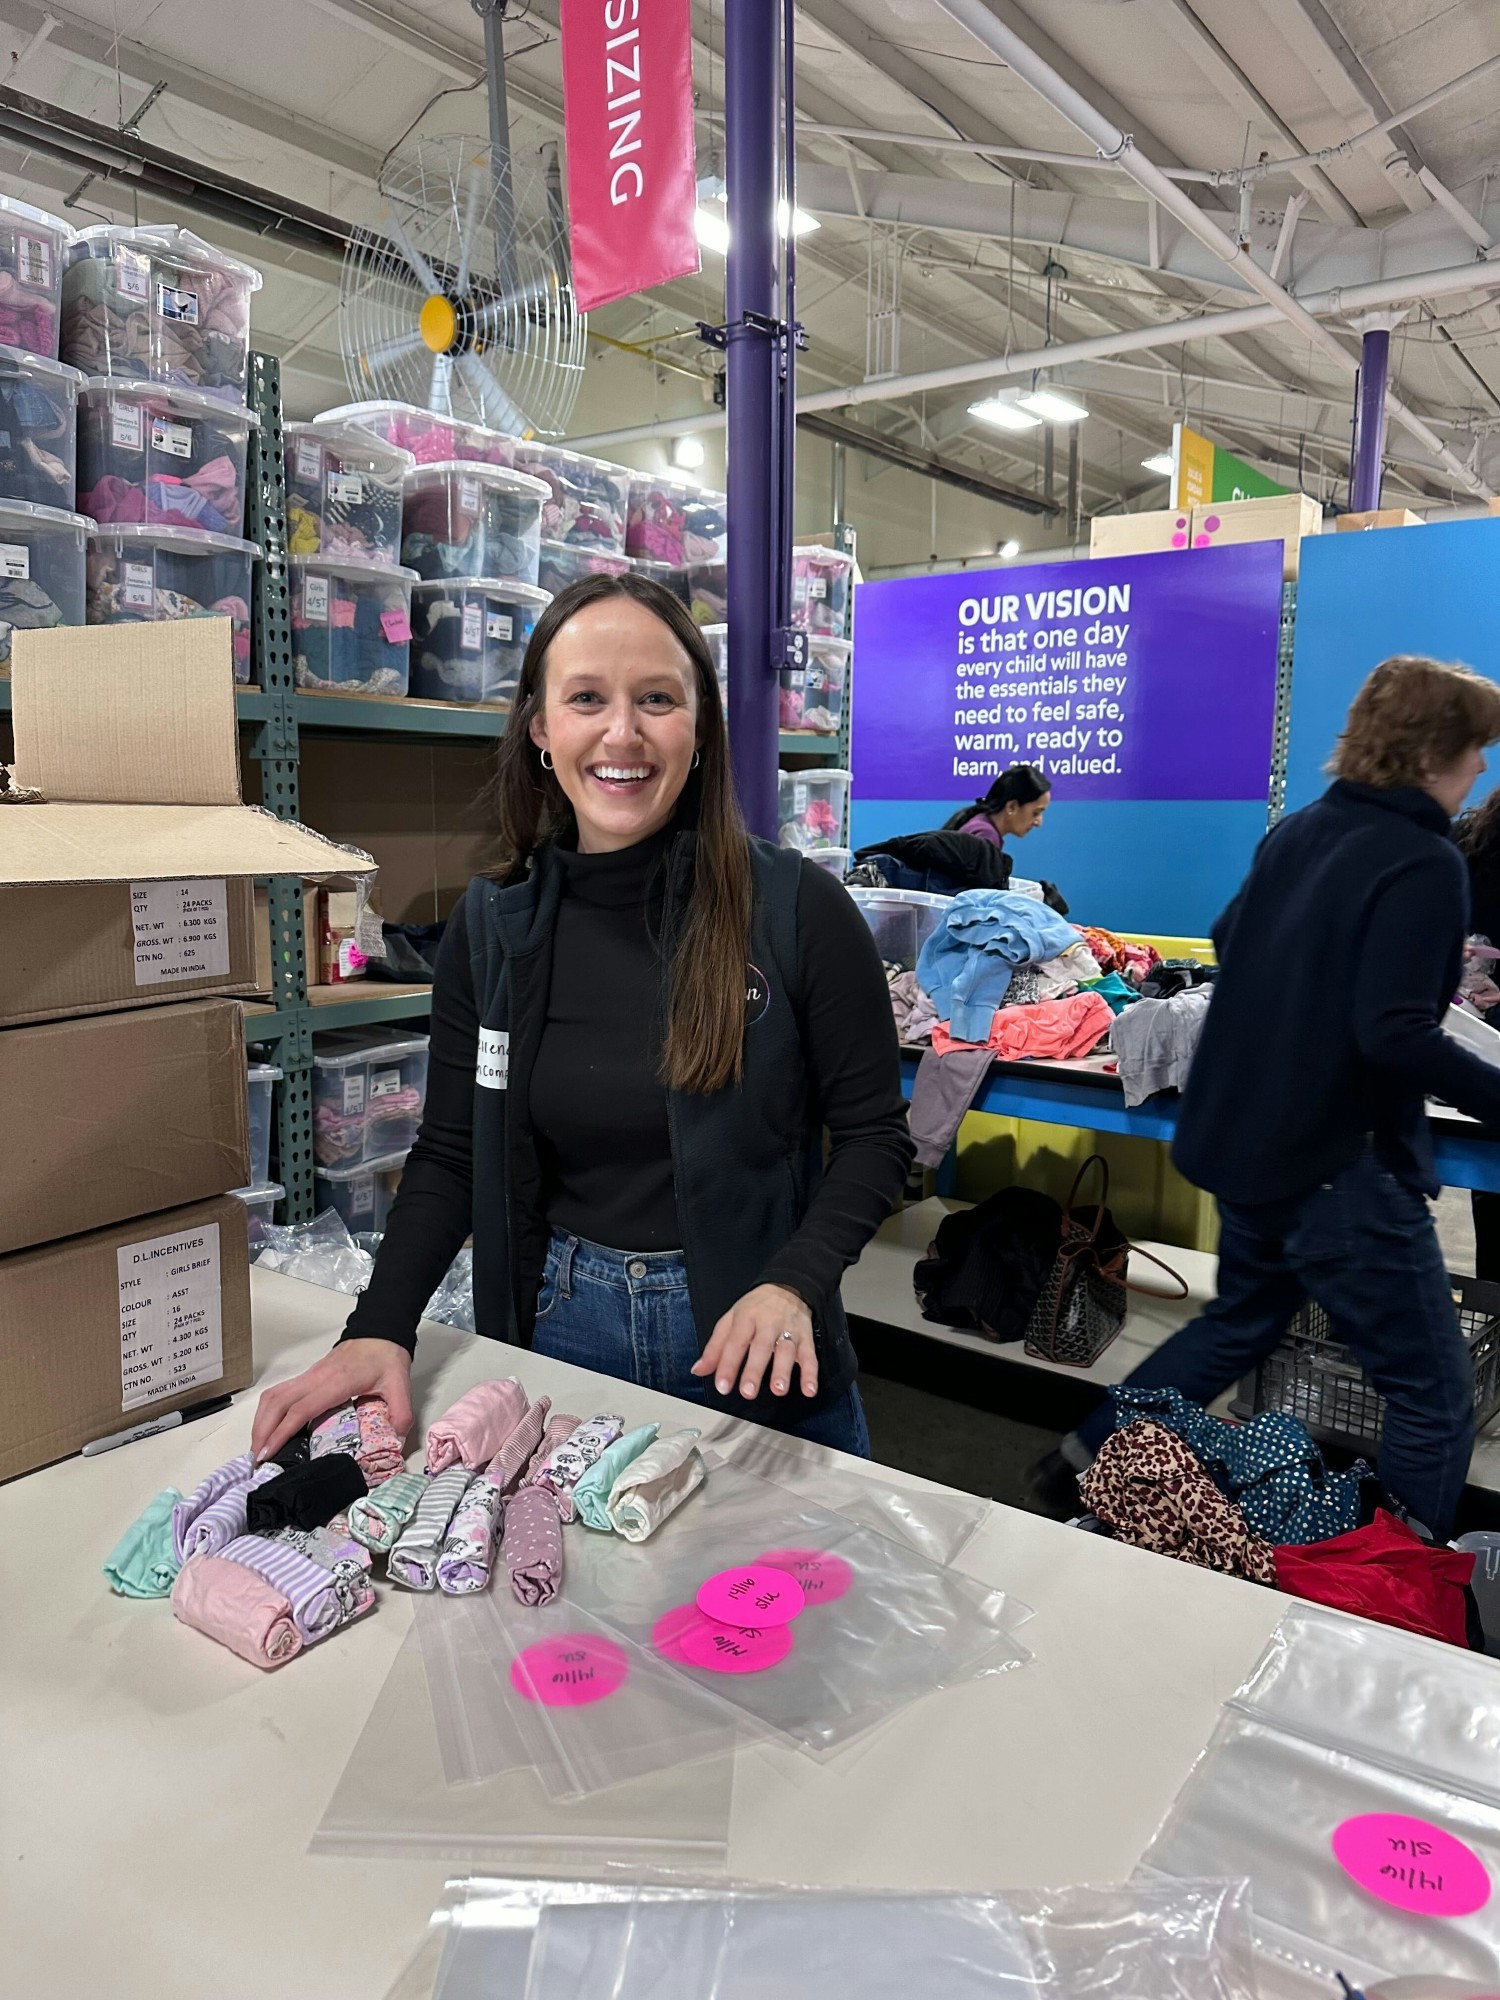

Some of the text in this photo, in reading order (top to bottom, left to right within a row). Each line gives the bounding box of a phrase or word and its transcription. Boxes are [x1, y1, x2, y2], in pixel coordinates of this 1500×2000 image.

[605, 0, 643, 206] SIZING
[127, 282, 140, 291] 5/6
[120, 433, 132, 441] 5/6
[132, 594, 145, 602] 5/6
[307, 596, 327, 608] 4/5T
[959, 584, 1131, 626] OUR VISION
[959, 620, 1130, 654] is that one day
[956, 650, 1127, 679] every child will have
[955, 673, 1127, 699] the essentials they
[954, 698, 1125, 725] need to feel safe,
[954, 725, 1123, 752] warm, ready to
[953, 757, 1002, 777] learn,
[1049, 753, 1122, 774] valued.
[133, 905, 148, 913] QTY
[153, 922, 164, 930] WT
[183, 919, 201, 927] 6.300
[136, 939, 161, 947] GROSS.
[161, 967, 179, 975] MADE
[188, 964, 206, 972] INDIA
[133, 1238, 204, 1264] D.L.INCENTIVES
[120, 1278, 141, 1290] STYLE
[171, 1264, 190, 1276] GIRLS
[192, 1258, 211, 1270] BRIEF
[121, 1299, 152, 1313] COLOUR
[172, 1288, 189, 1298] ASST
[122, 1319, 136, 1329] SIZE
[172, 1306, 181, 1314] 16
[122, 1331, 137, 1342] QTY
[184, 1310, 205, 1321] PACKS
[123, 1349, 139, 1360] NET.
[140, 1344, 153, 1354] WT
[172, 1332, 191, 1343] 4.300
[194, 1326, 208, 1336] KGS
[123, 1363, 150, 1376] GROSS.
[151, 1357, 163, 1367] WT
[173, 1347, 192, 1360] 5.200
[195, 1342, 209, 1352] KGS
[123, 1380, 138, 1391] CTN
[140, 1376, 154, 1385] NO.
[174, 1364, 187, 1374] 523
[147, 1384, 168, 1397] MADE
[178, 1375, 196, 1386] INDIA
[728, 1578, 755, 1600] 14/16
[552, 1667, 594, 1684] 14/16
[1380, 1865, 1443, 1891] 14/16
